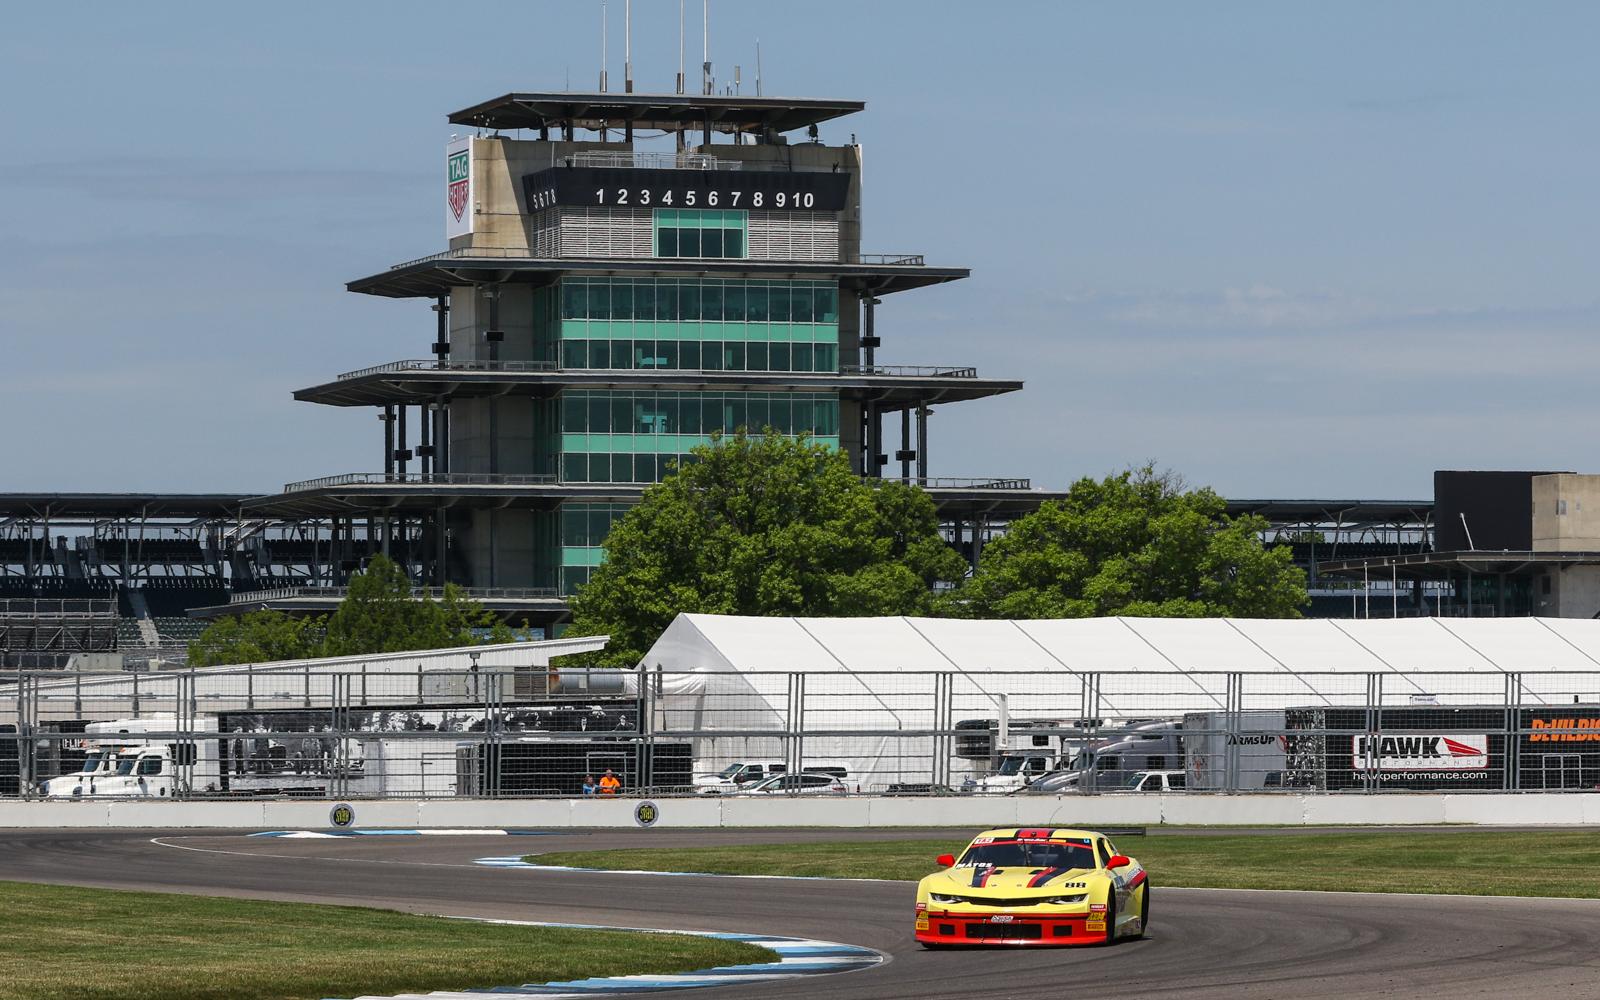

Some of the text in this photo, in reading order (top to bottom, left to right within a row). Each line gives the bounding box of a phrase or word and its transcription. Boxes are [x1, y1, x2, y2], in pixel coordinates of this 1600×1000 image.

[450, 156, 467, 180] TAG
[532, 188, 556, 209] 5 6 7 8
[596, 188, 814, 208] 1 2 3 4 5 6 7 8 9 10
[1358, 737, 1441, 759] HAWK
[1353, 771, 1488, 782] hawkperformance.com
